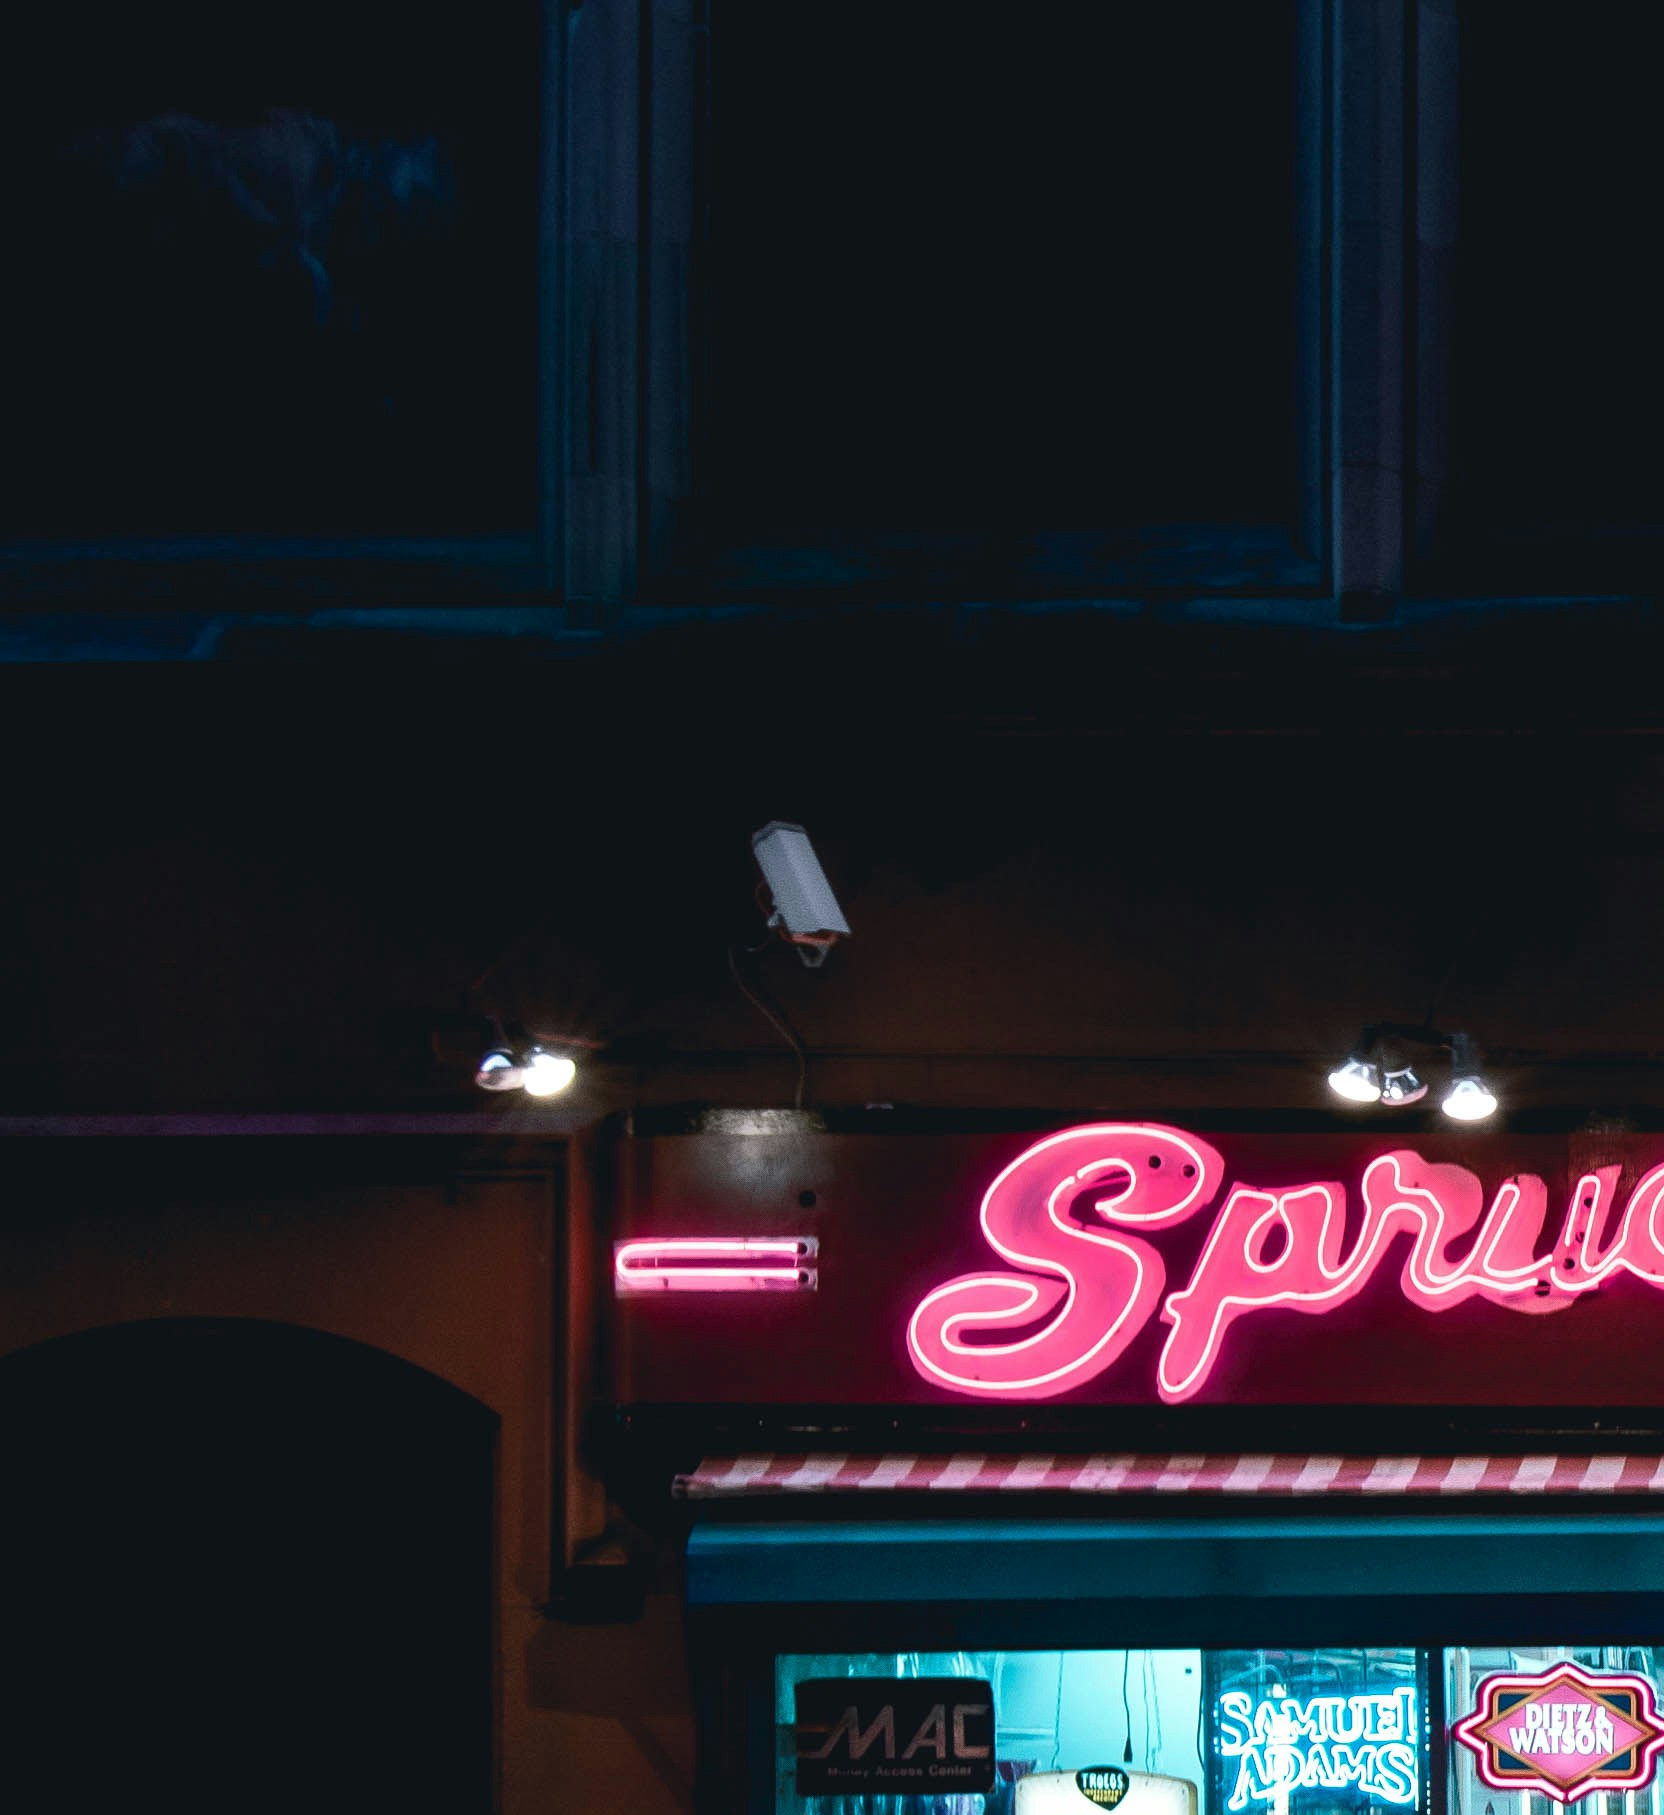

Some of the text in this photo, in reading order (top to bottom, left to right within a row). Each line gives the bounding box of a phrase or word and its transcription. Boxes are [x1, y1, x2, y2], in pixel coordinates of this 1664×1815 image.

[802, 1703, 990, 1760] MAC
[1219, 1686, 1417, 1756] SAMUEL
[1525, 1702, 1614, 1729] DIETZ &
[1508, 1726, 1615, 1756] WATSON
[928, 1765, 973, 1777] Center
[1227, 1742, 1417, 1811] ADAMS
